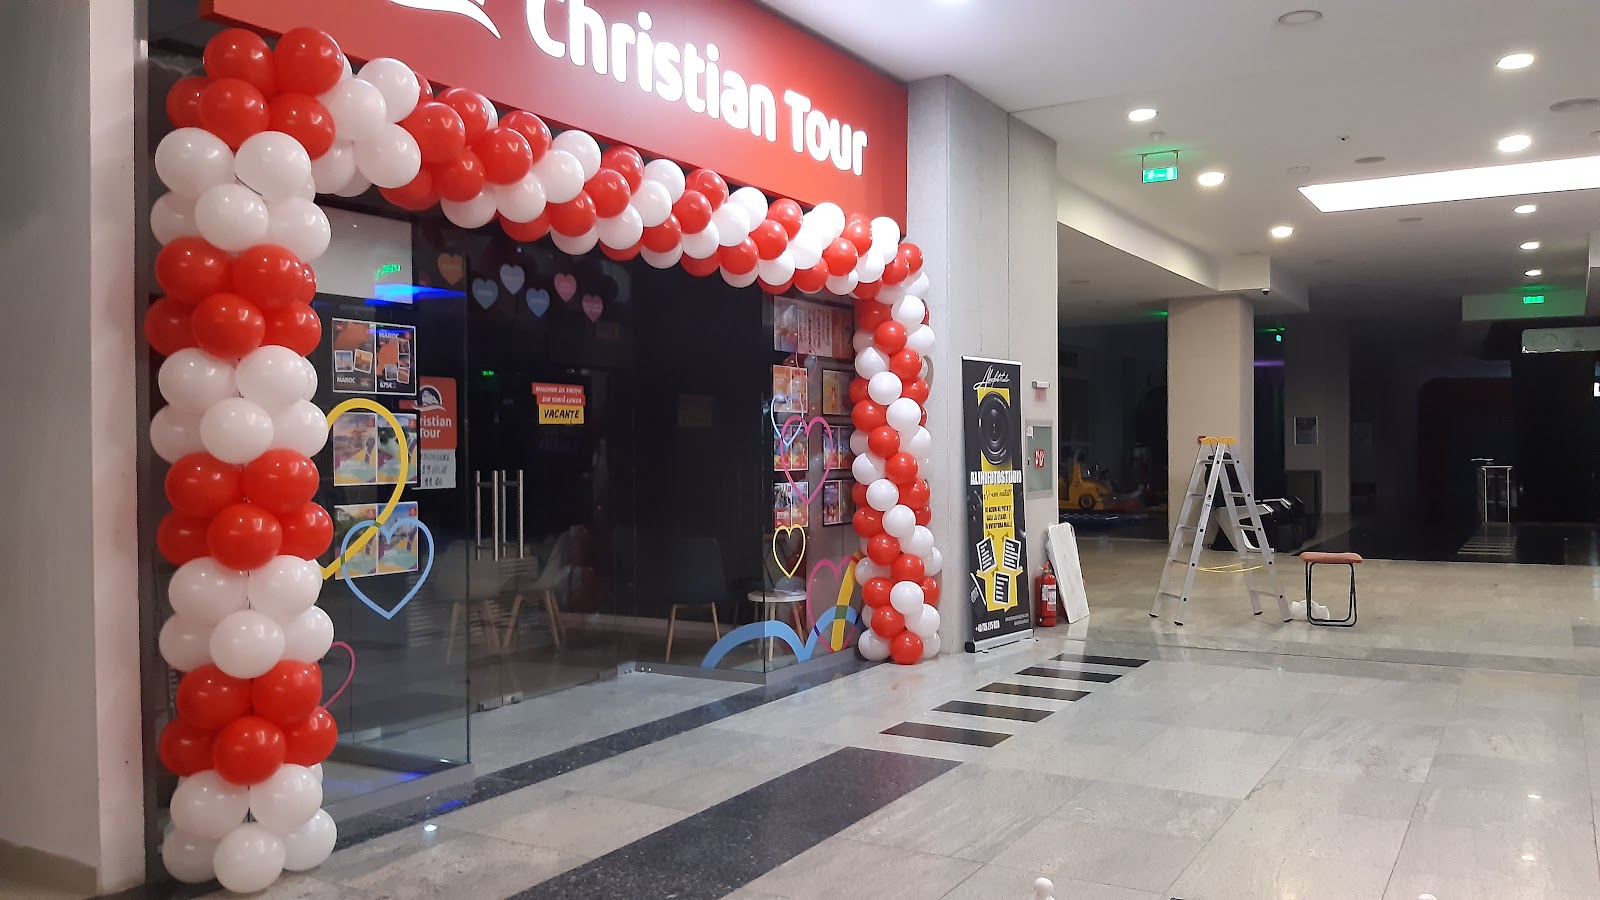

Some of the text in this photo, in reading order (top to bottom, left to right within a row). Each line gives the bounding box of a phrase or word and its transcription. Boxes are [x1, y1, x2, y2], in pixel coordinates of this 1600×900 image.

[526, 0, 868, 177] Christian Tour
[378, 332, 399, 340] MAROC
[336, 376, 356, 384] MAROC
[419, 415, 452, 427] ristian
[420, 427, 441, 438] Tour
